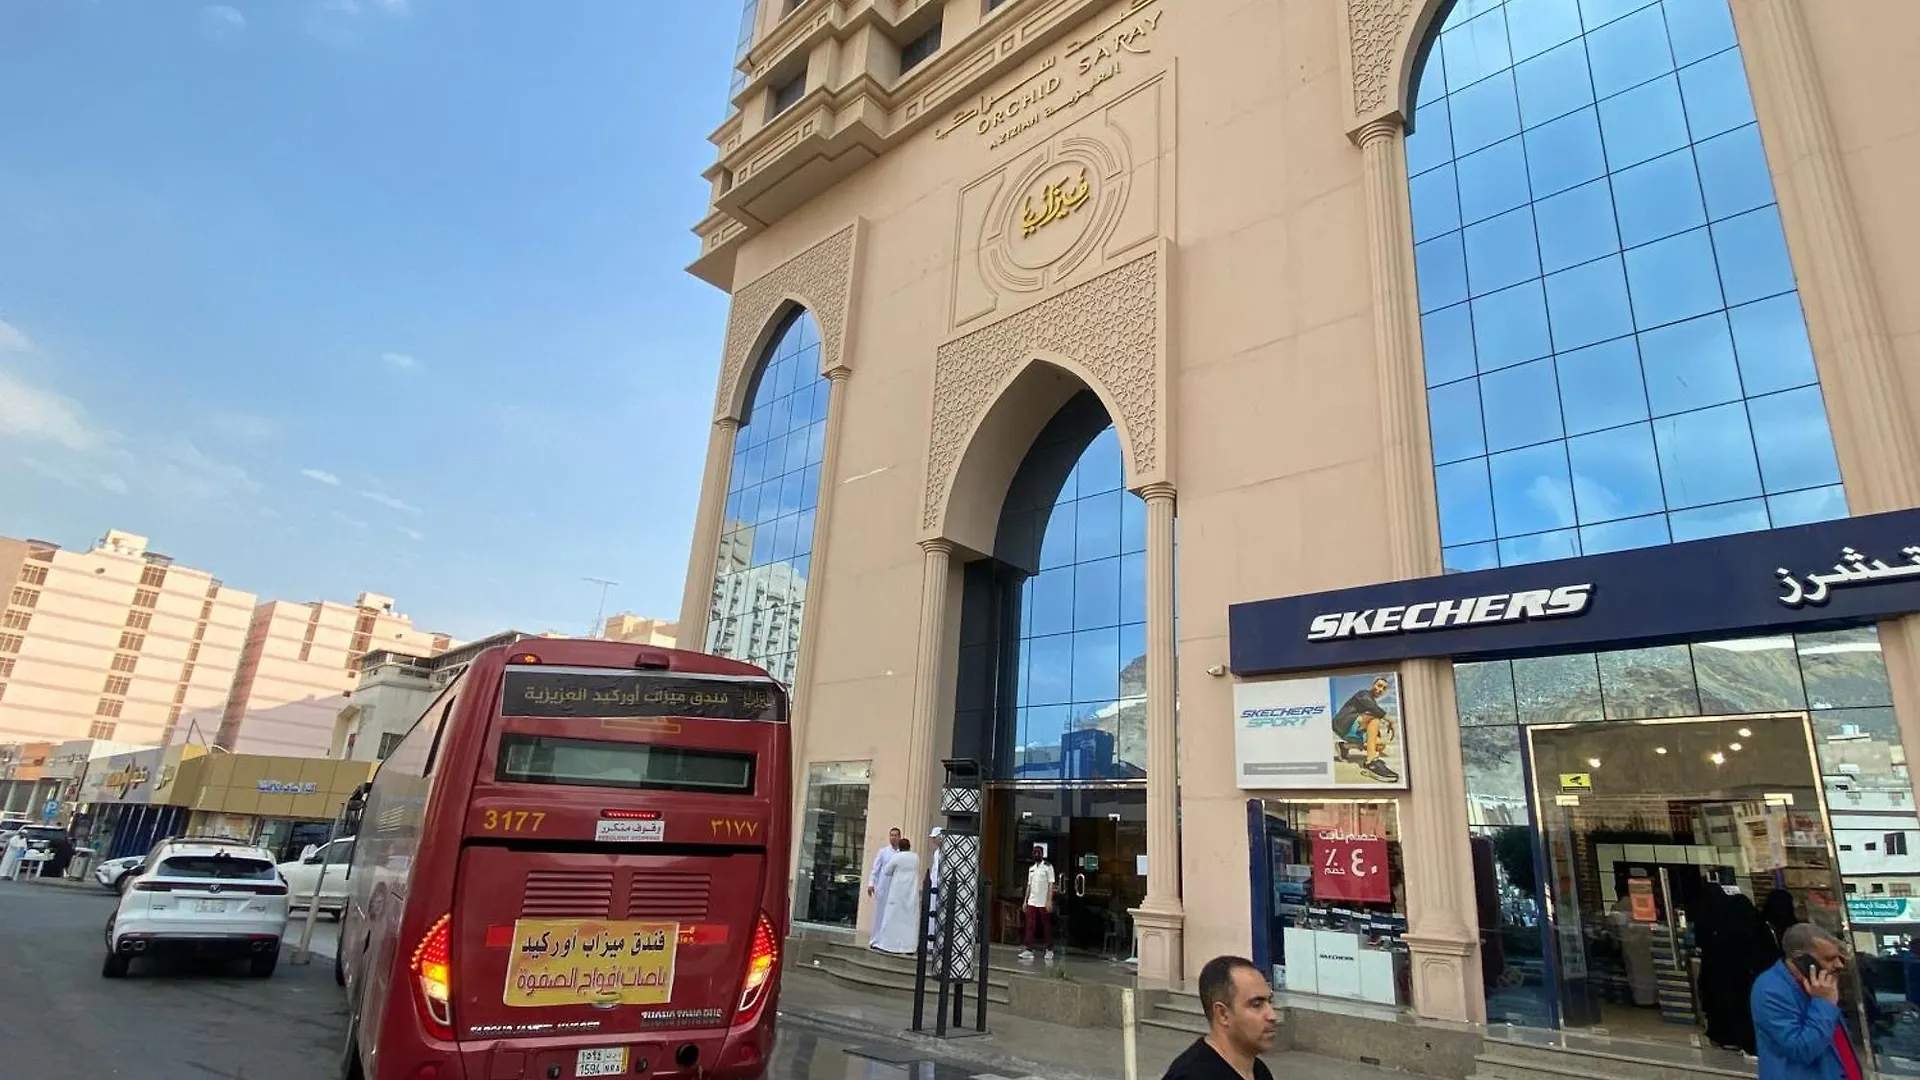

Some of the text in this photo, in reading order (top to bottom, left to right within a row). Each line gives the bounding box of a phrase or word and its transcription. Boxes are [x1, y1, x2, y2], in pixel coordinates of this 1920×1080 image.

[976, 10, 1163, 135] ORCHID SARAY
[989, 115, 1039, 150] AZIZIAH
[1776, 546, 1920, 603] تشرز
[1308, 583, 1594, 641] SKECHERS
[524, 685, 587, 704] العزيزية
[592, 683, 640, 705] أوركيد
[690, 691, 728, 706] فندق
[1240, 705, 1326, 718] SKECHERS
[1246, 714, 1314, 728] SPORT
[483, 810, 546, 832] 3177
[711, 819, 758, 837] ٣١٧٧
[521, 929, 577, 958] أوركيد
[582, 932, 625, 957] ميزاب
[630, 930, 665, 957] فندق
[517, 966, 577, 995] الصفوة
[621, 964, 667, 991] باصات
